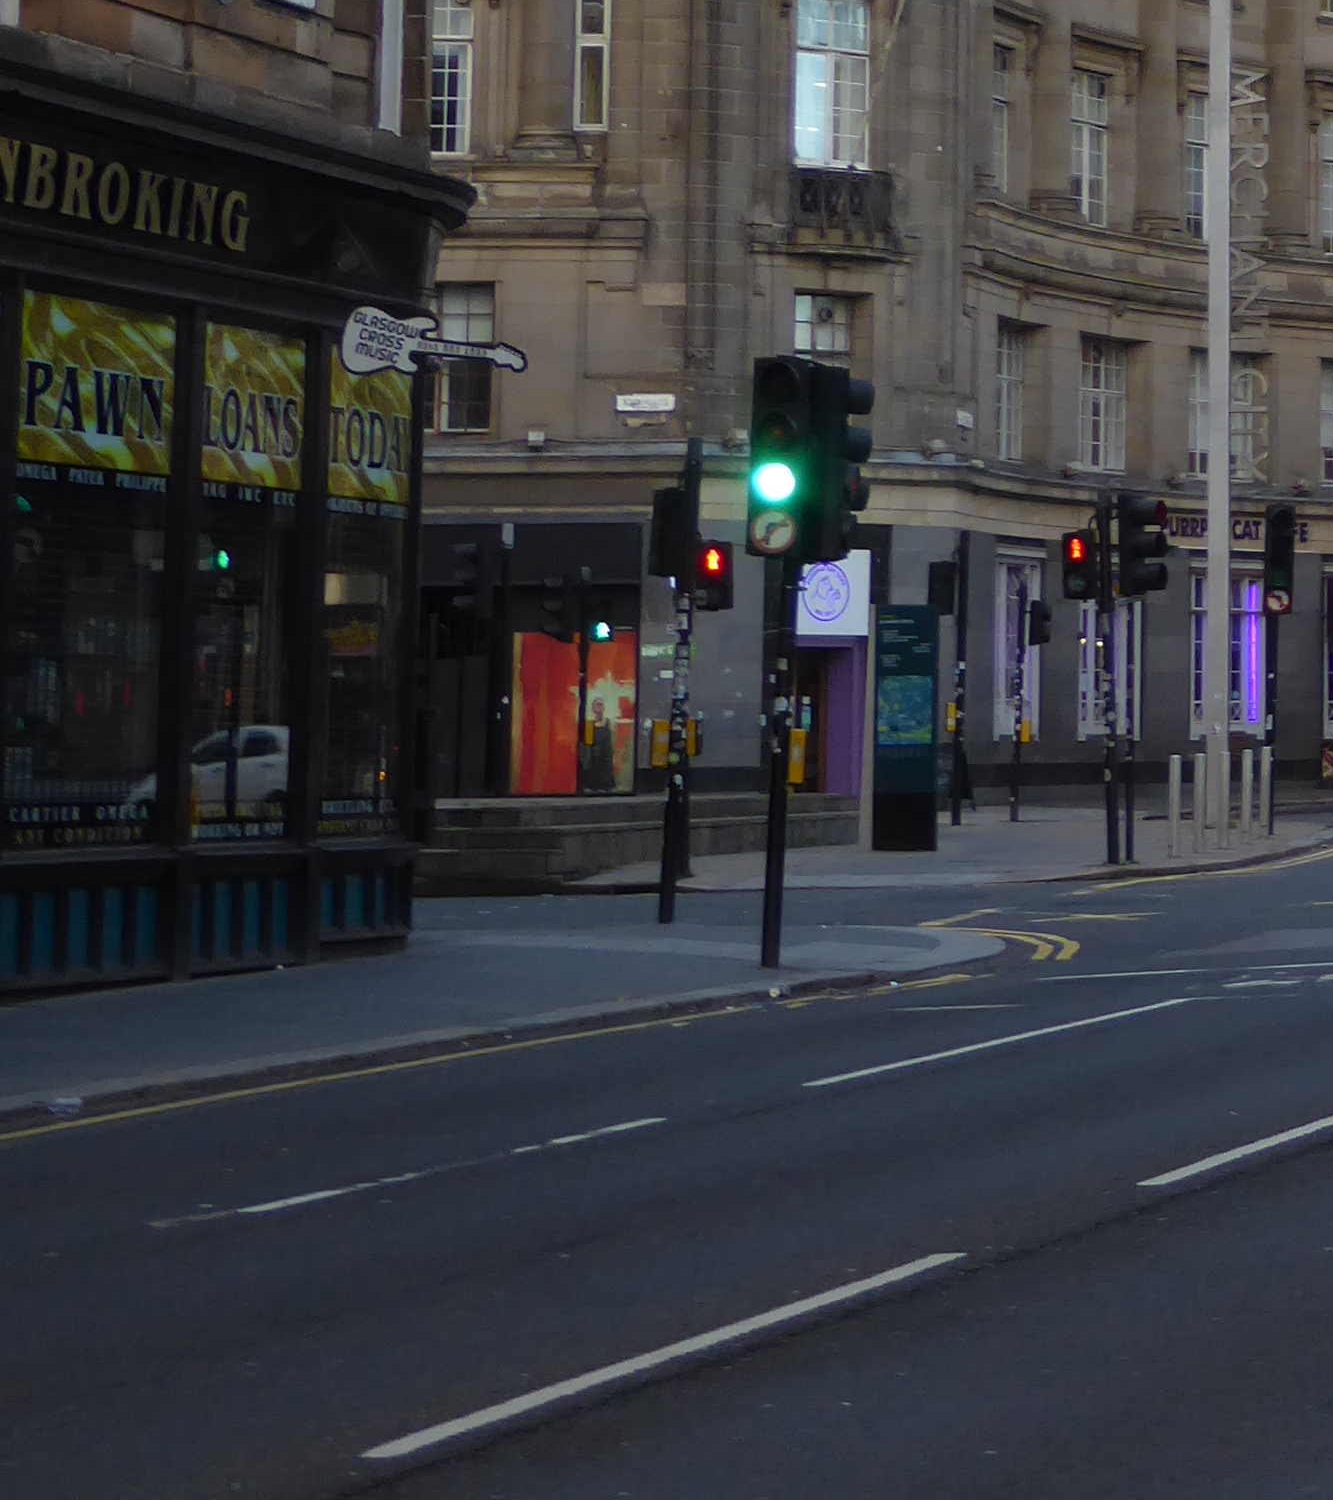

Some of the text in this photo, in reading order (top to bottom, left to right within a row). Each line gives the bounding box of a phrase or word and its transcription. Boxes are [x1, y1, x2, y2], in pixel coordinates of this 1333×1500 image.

[354, 311, 419, 340] GLASGOW
[359, 327, 405, 351] CROSS
[355, 342, 400, 365] MUSIC
[24, 360, 165, 442] PAWN
[203, 384, 300, 458] LOANS
[1232, 519, 1262, 541] CAT
